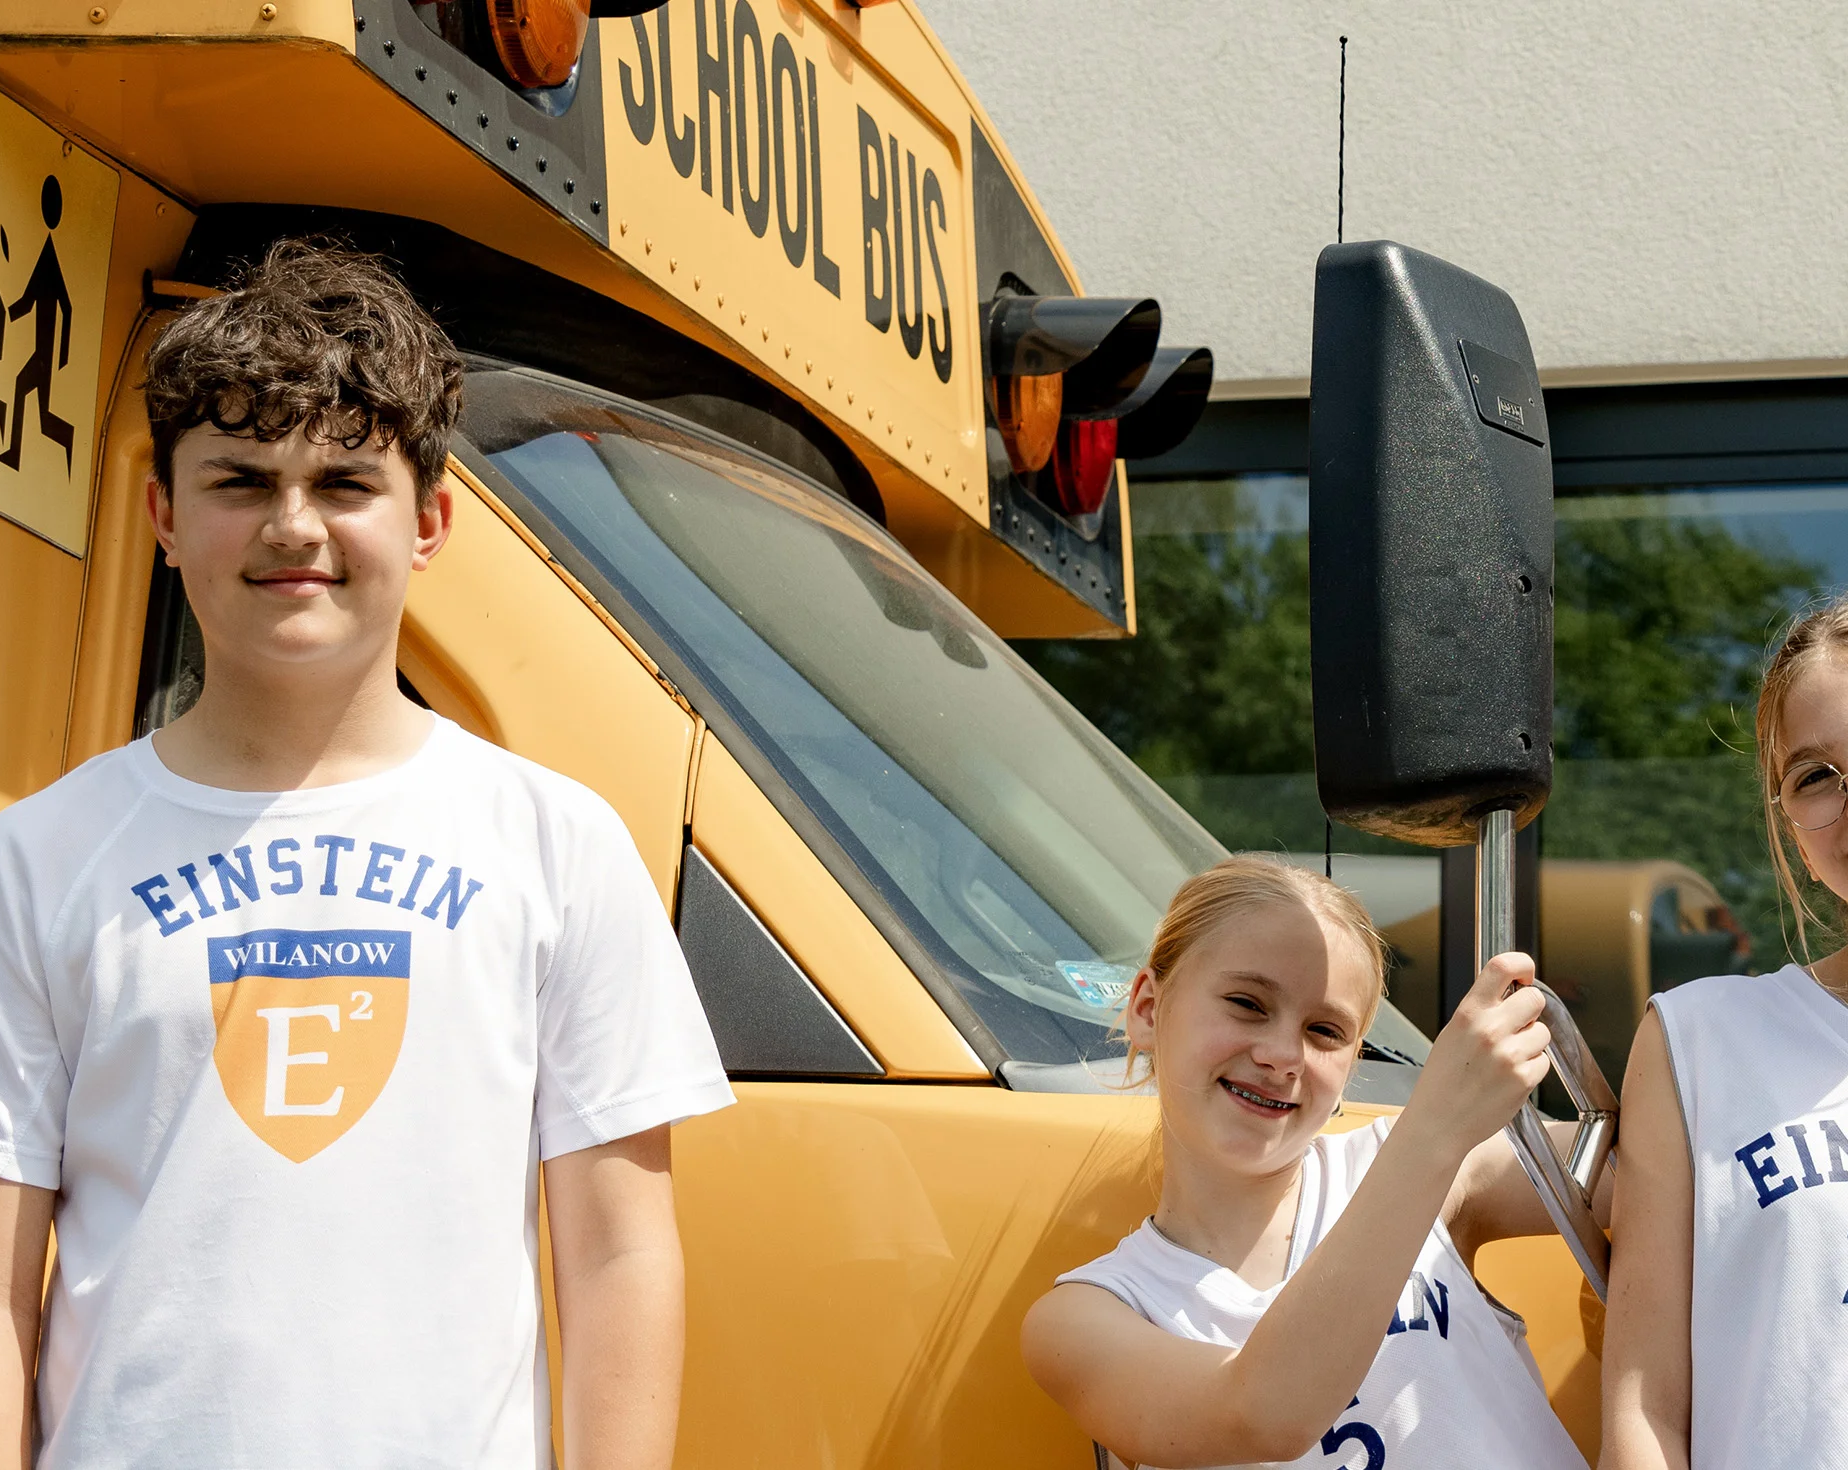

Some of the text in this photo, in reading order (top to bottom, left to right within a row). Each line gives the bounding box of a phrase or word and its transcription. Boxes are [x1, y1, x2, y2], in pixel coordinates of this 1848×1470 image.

[618, 0, 952, 384] SCHOOL BUS
[131, 835, 483, 937] EINSTEIN
[224, 942, 396, 970] WILANOW
